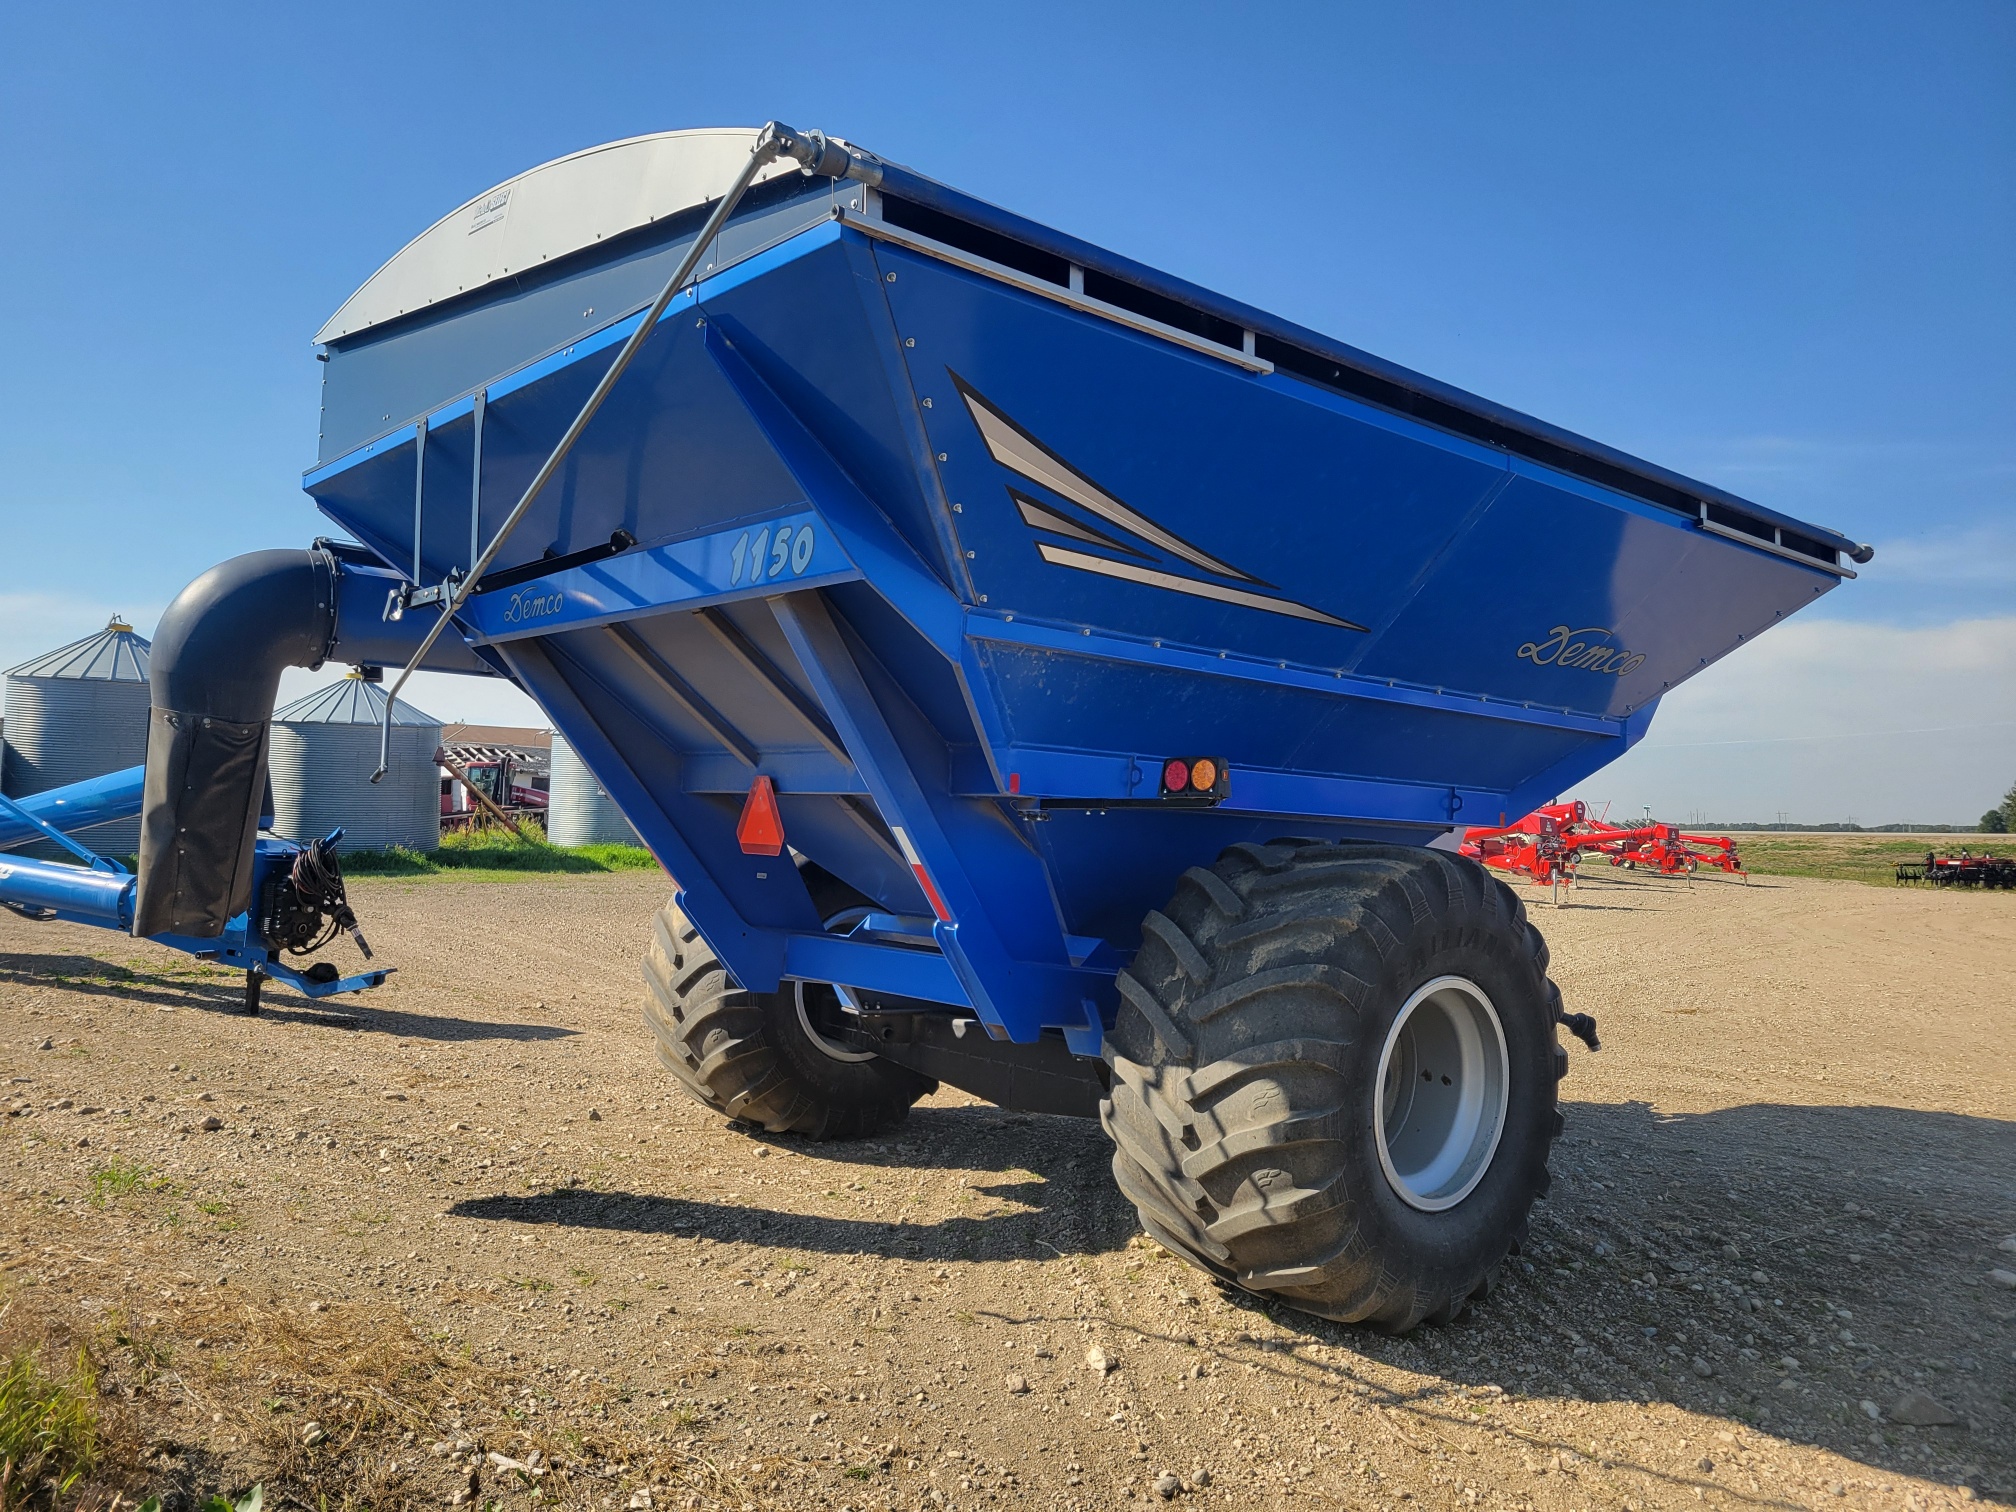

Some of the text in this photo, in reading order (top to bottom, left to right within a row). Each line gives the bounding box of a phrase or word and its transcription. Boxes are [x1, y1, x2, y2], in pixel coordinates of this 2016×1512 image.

[729, 525, 815, 587] 1150
[503, 586, 564, 623] Demco
[1516, 625, 1647, 676] Demco
